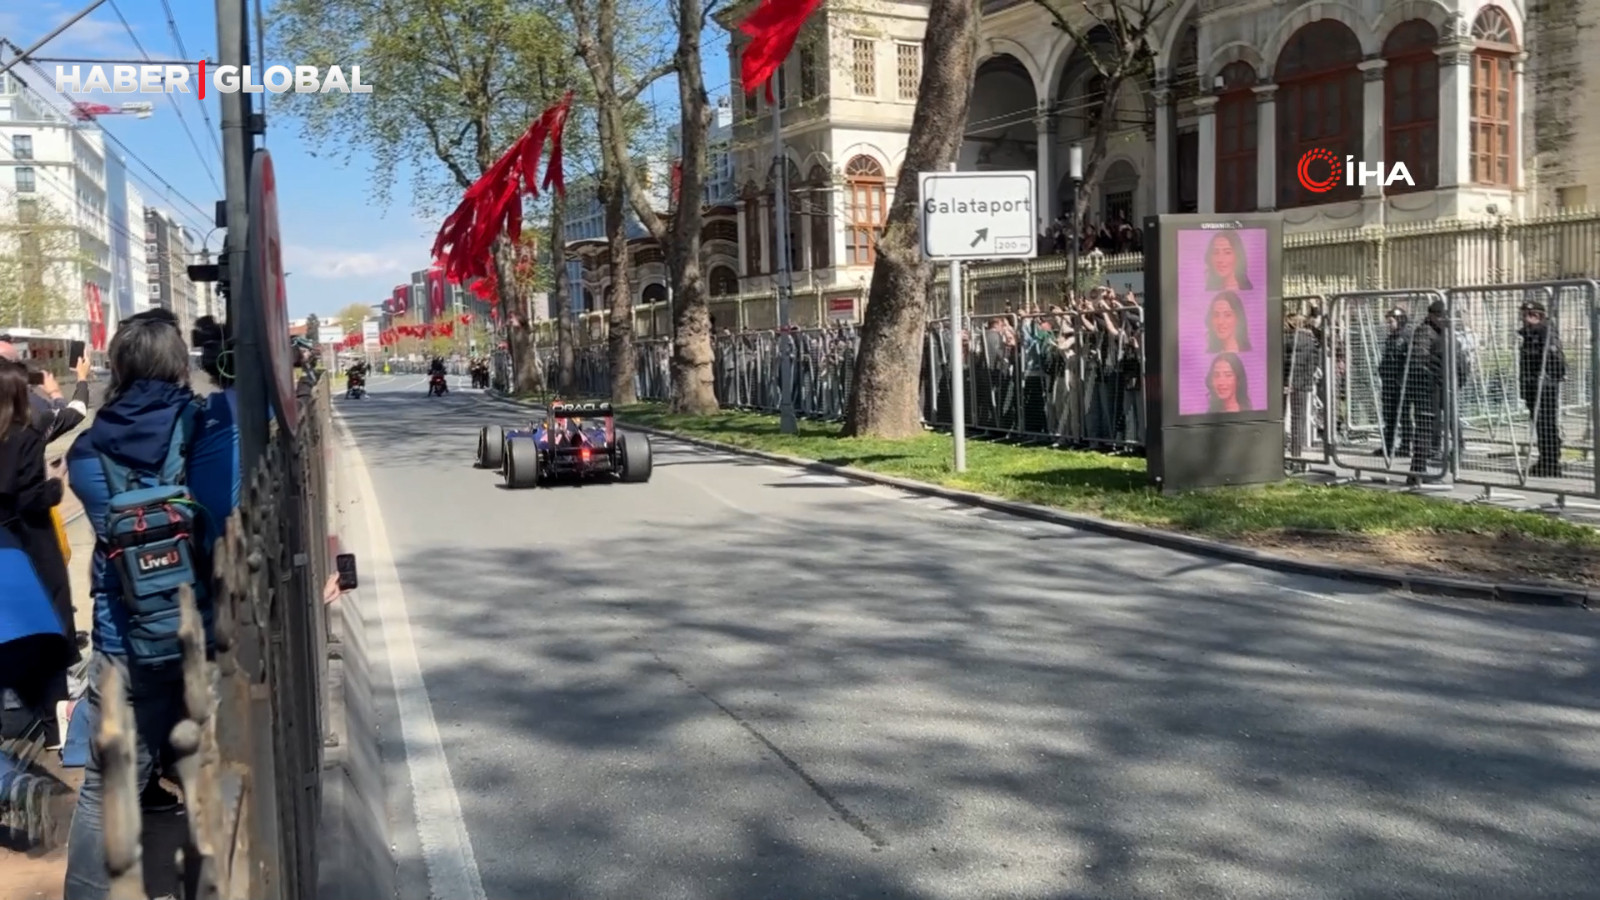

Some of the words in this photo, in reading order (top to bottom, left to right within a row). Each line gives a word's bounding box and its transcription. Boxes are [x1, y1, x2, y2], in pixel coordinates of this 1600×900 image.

[925, 197, 1031, 217] Galataport
[998, 241, 1018, 249] 200
[552, 402, 609, 411] ORACLE
[139, 550, 179, 570] LiveU
